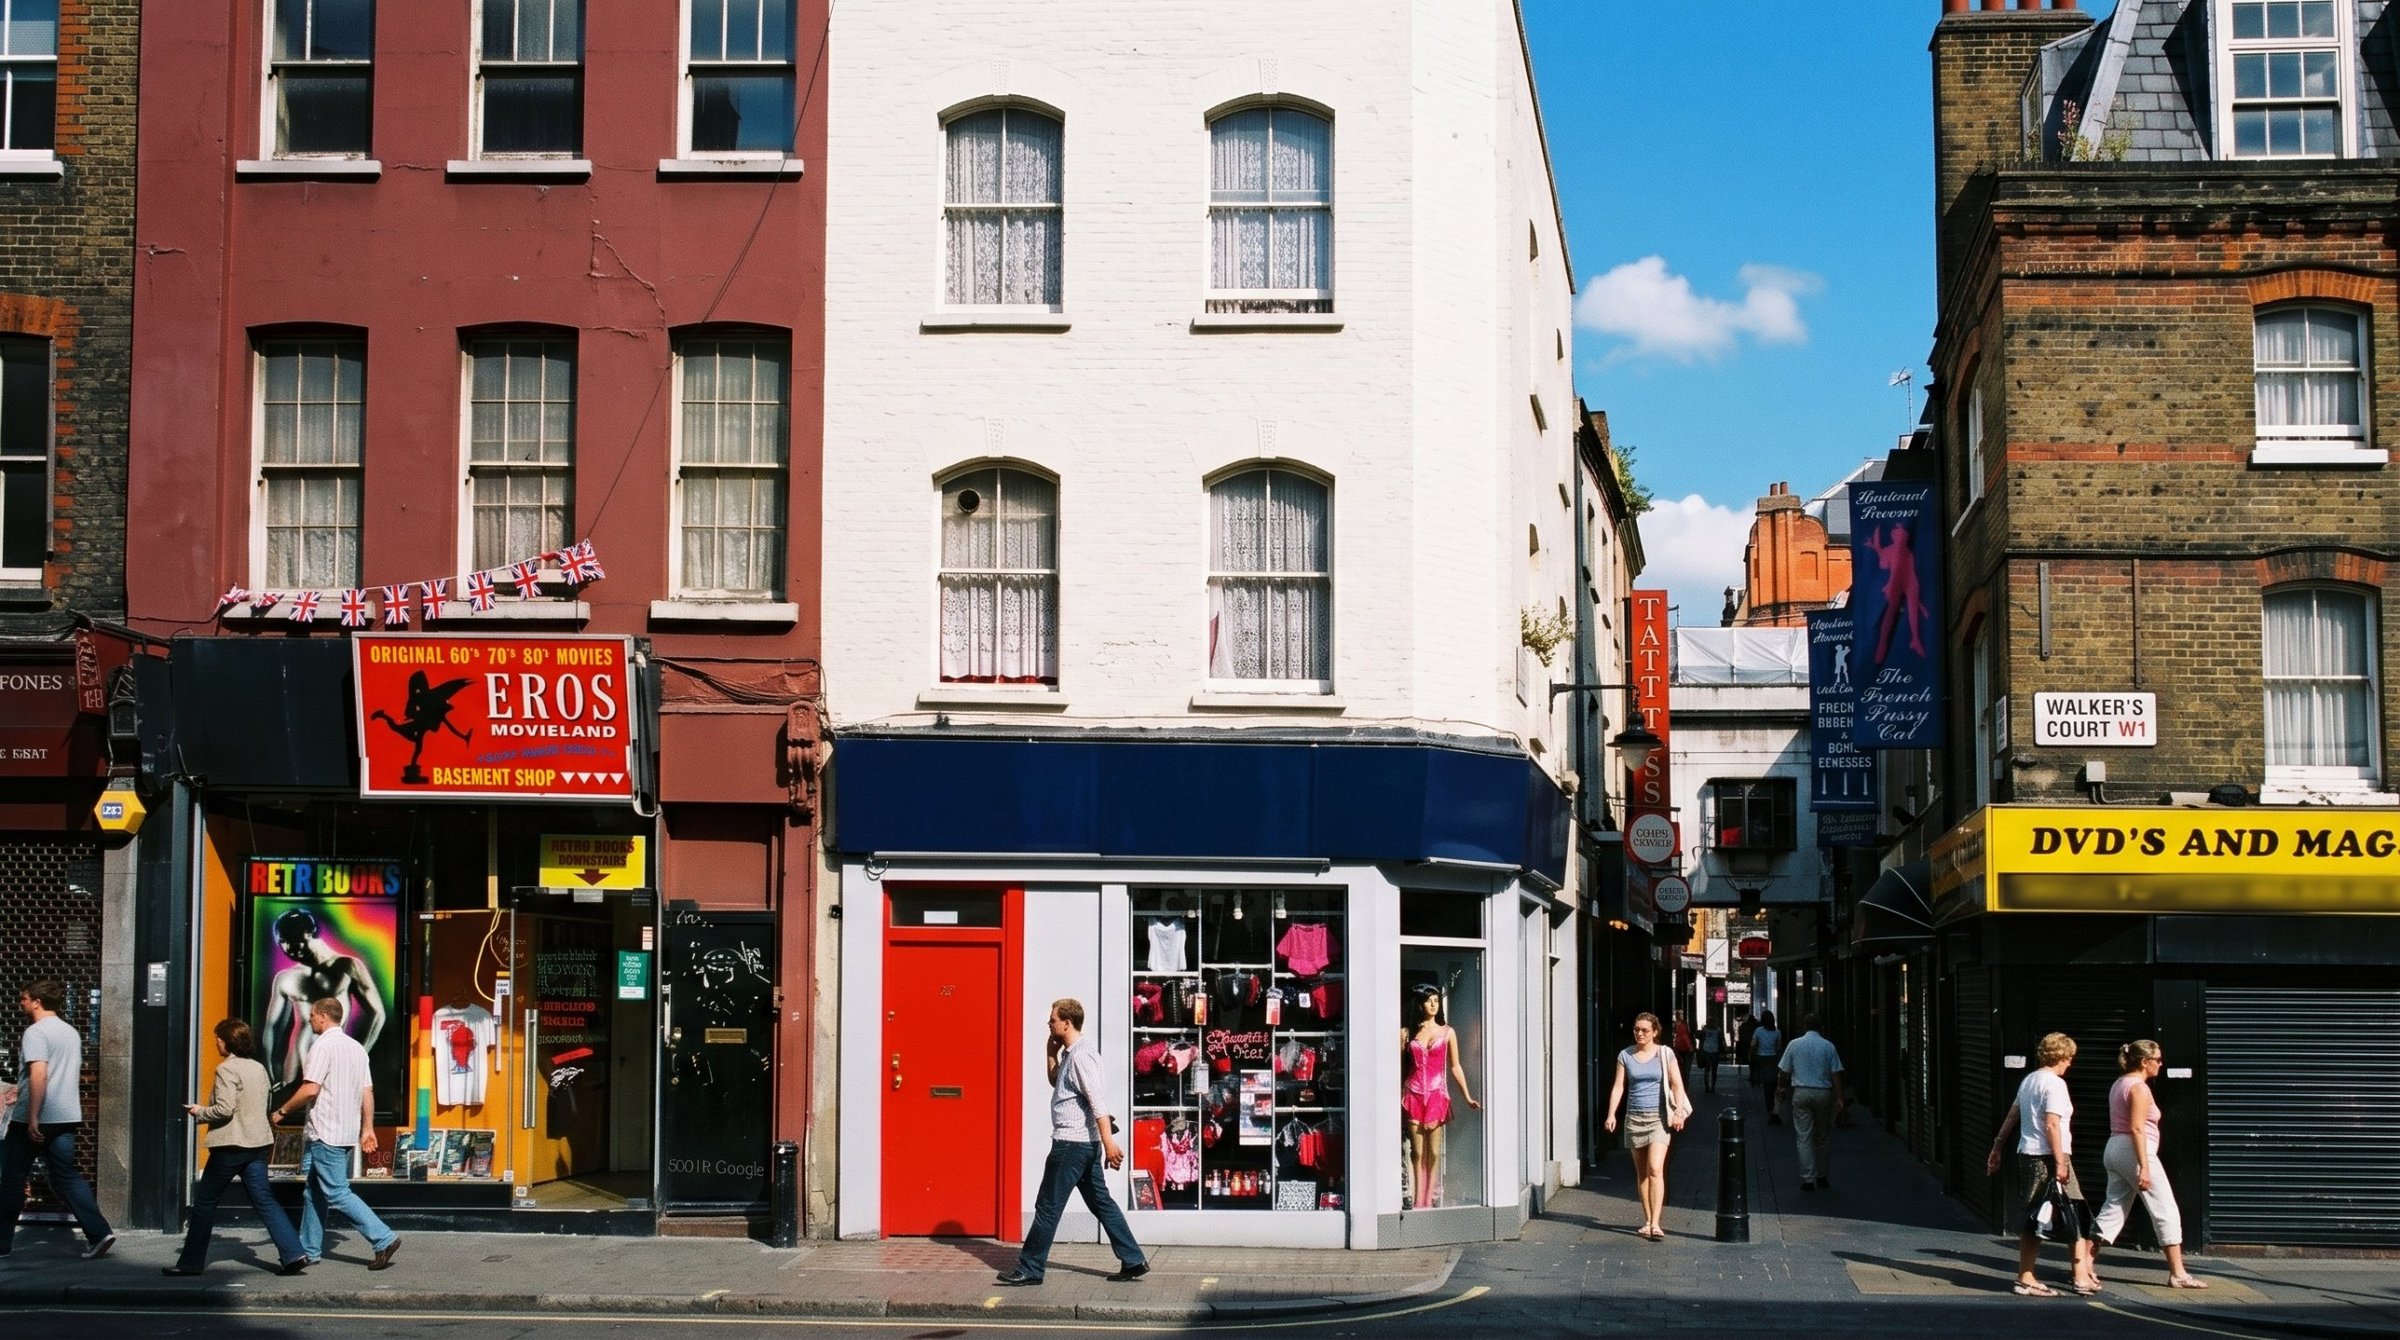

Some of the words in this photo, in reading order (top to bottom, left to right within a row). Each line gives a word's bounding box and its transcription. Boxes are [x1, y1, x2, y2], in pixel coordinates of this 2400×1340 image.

[370, 645, 445, 664] ORIGINAL
[450, 646, 480, 664] 60's
[487, 647, 516, 665] 70's
[556, 647, 613, 665] MOVIES
[1876, 668, 1914, 684] The
[484, 672, 617, 721] EROS
[1865, 704, 1930, 728] Pussy
[2046, 699, 2144, 716] WALKER'S
[491, 723, 617, 738] MOVIELAND
[2047, 720, 2112, 737] COURT
[2118, 720, 2146, 737] W1
[433, 767, 511, 786] BASEMENT
[515, 769, 557, 787] SHOP
[551, 840, 590, 853] RETRO
[594, 841, 635, 853] BOOKS
[2030, 827, 2166, 856] DVD'S
[2178, 829, 2279, 857] AND
[2292, 829, 2400, 858] MAG
[559, 855, 627, 866] DOWNSTAIRS
